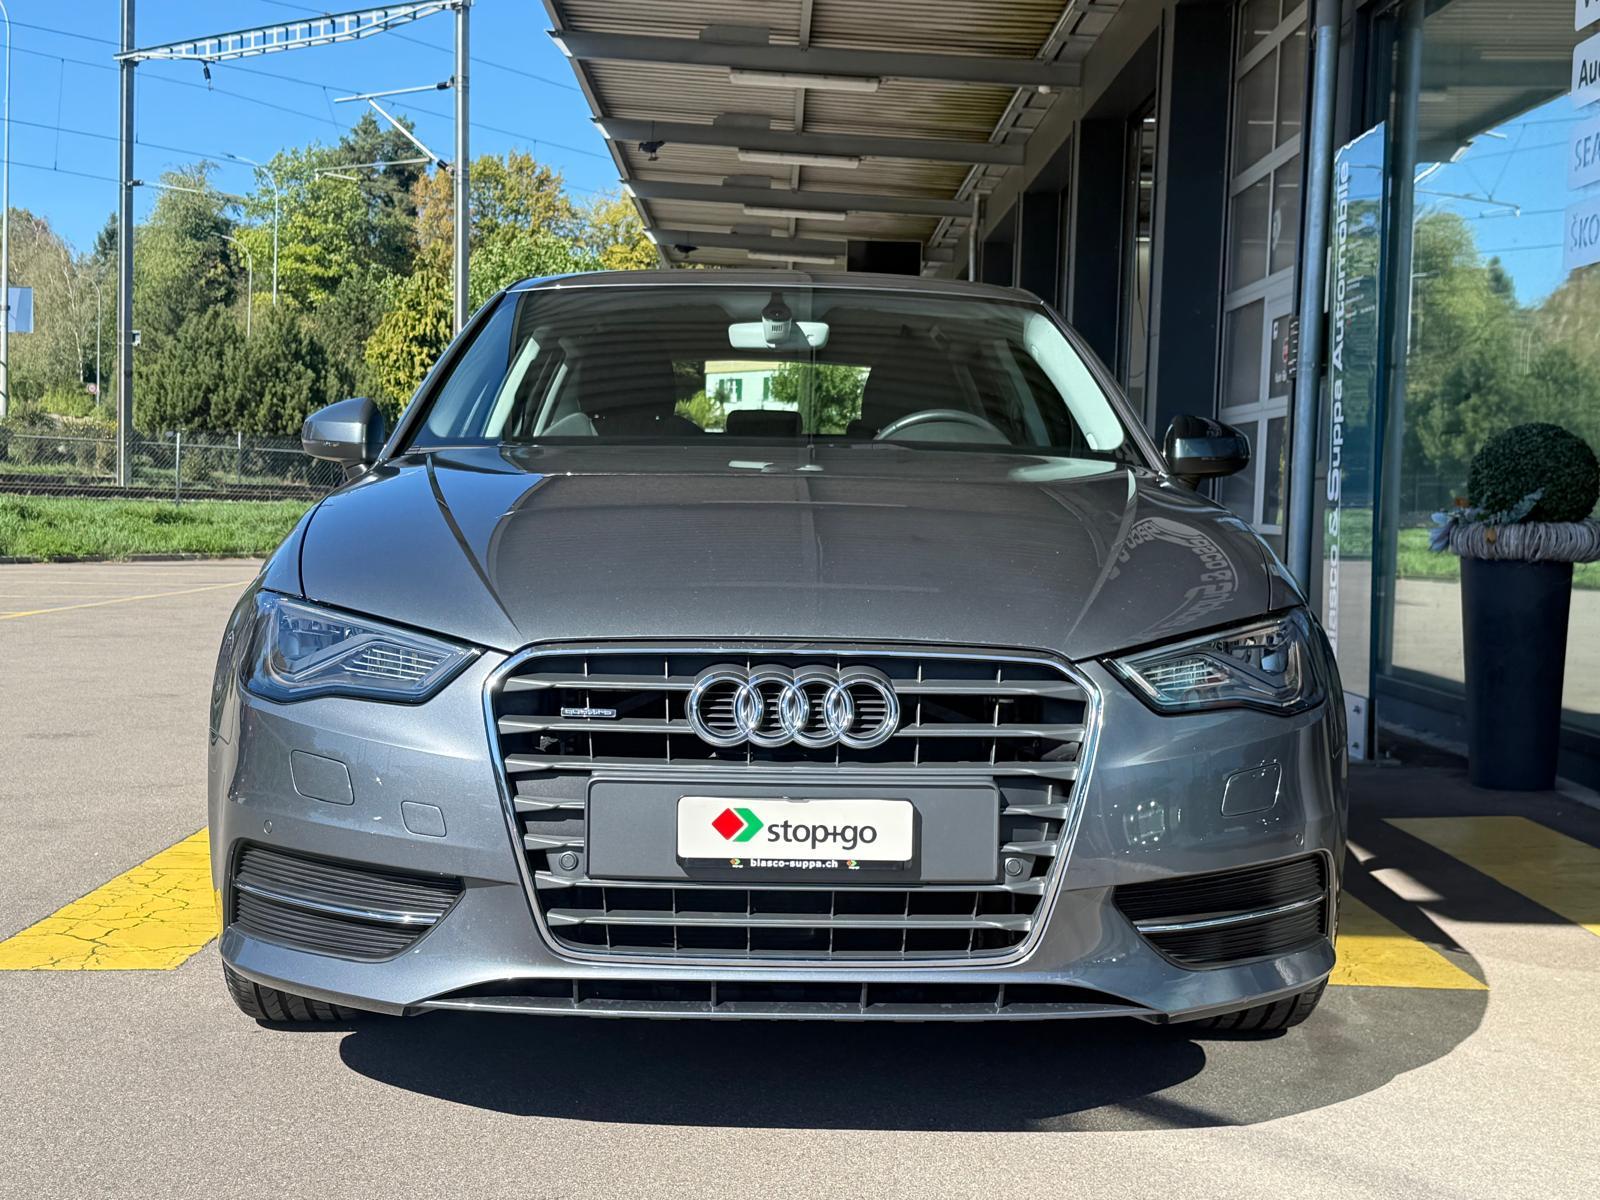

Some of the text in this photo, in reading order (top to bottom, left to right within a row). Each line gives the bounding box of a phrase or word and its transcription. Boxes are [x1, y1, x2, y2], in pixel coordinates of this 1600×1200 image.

[1332, 161, 1349, 371] Automobile
[1327, 379, 1344, 501] Suppa
[1328, 507, 1339, 537] &
[767, 819, 878, 850] stop+go
